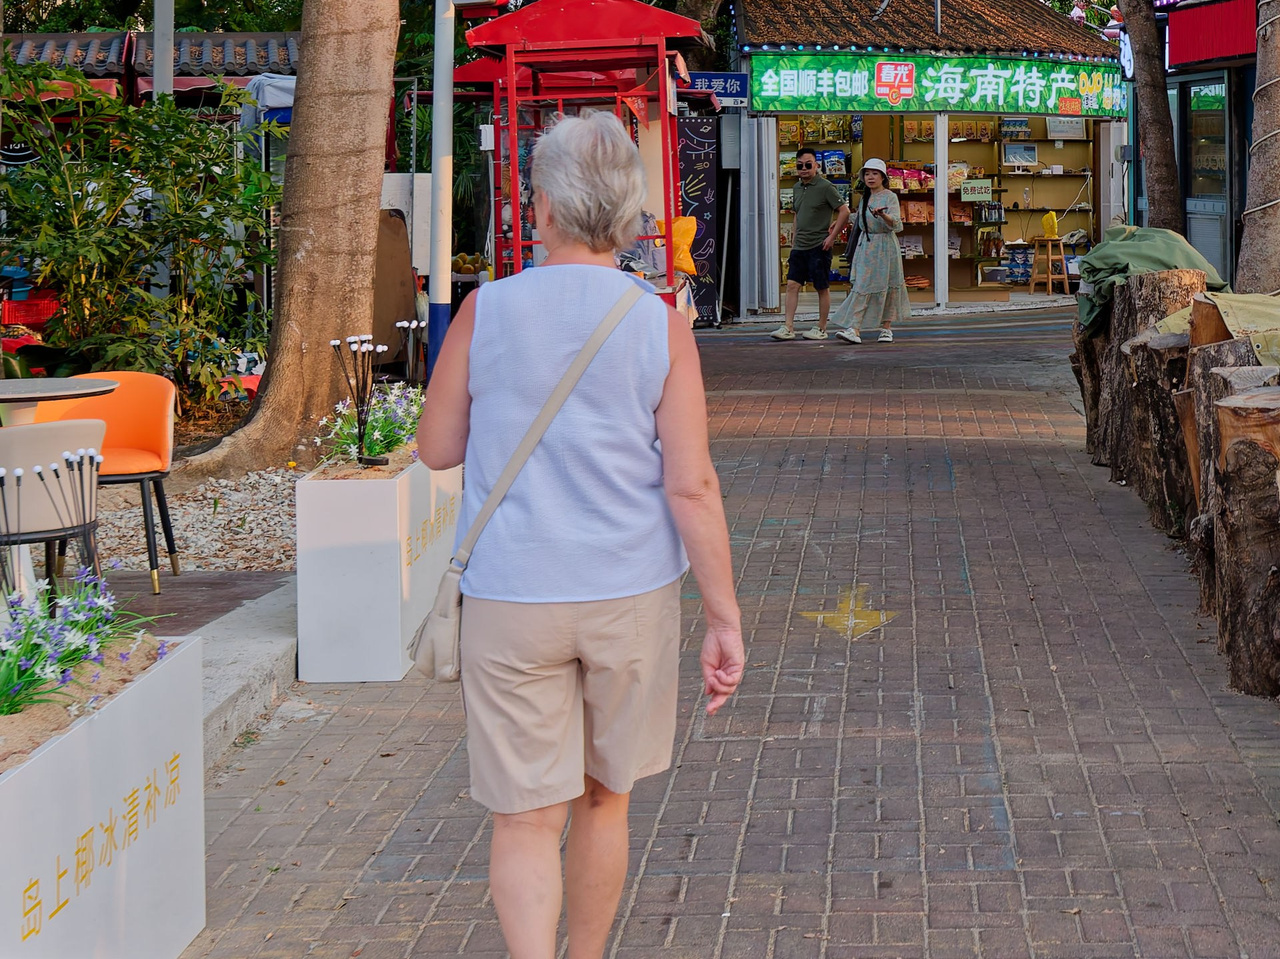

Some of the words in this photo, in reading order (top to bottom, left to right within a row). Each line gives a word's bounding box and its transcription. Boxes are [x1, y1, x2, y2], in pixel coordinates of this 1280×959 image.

[695, 78, 741, 93] 我爱你
[761, 69, 869, 97] 全国顺丰包邮
[880, 64, 909, 88] 春光
[921, 62, 1077, 108] 海南特产
[963, 186, 991, 195] 免费试吃
[21, 751, 181, 942] 岛上椰冰清补凉
